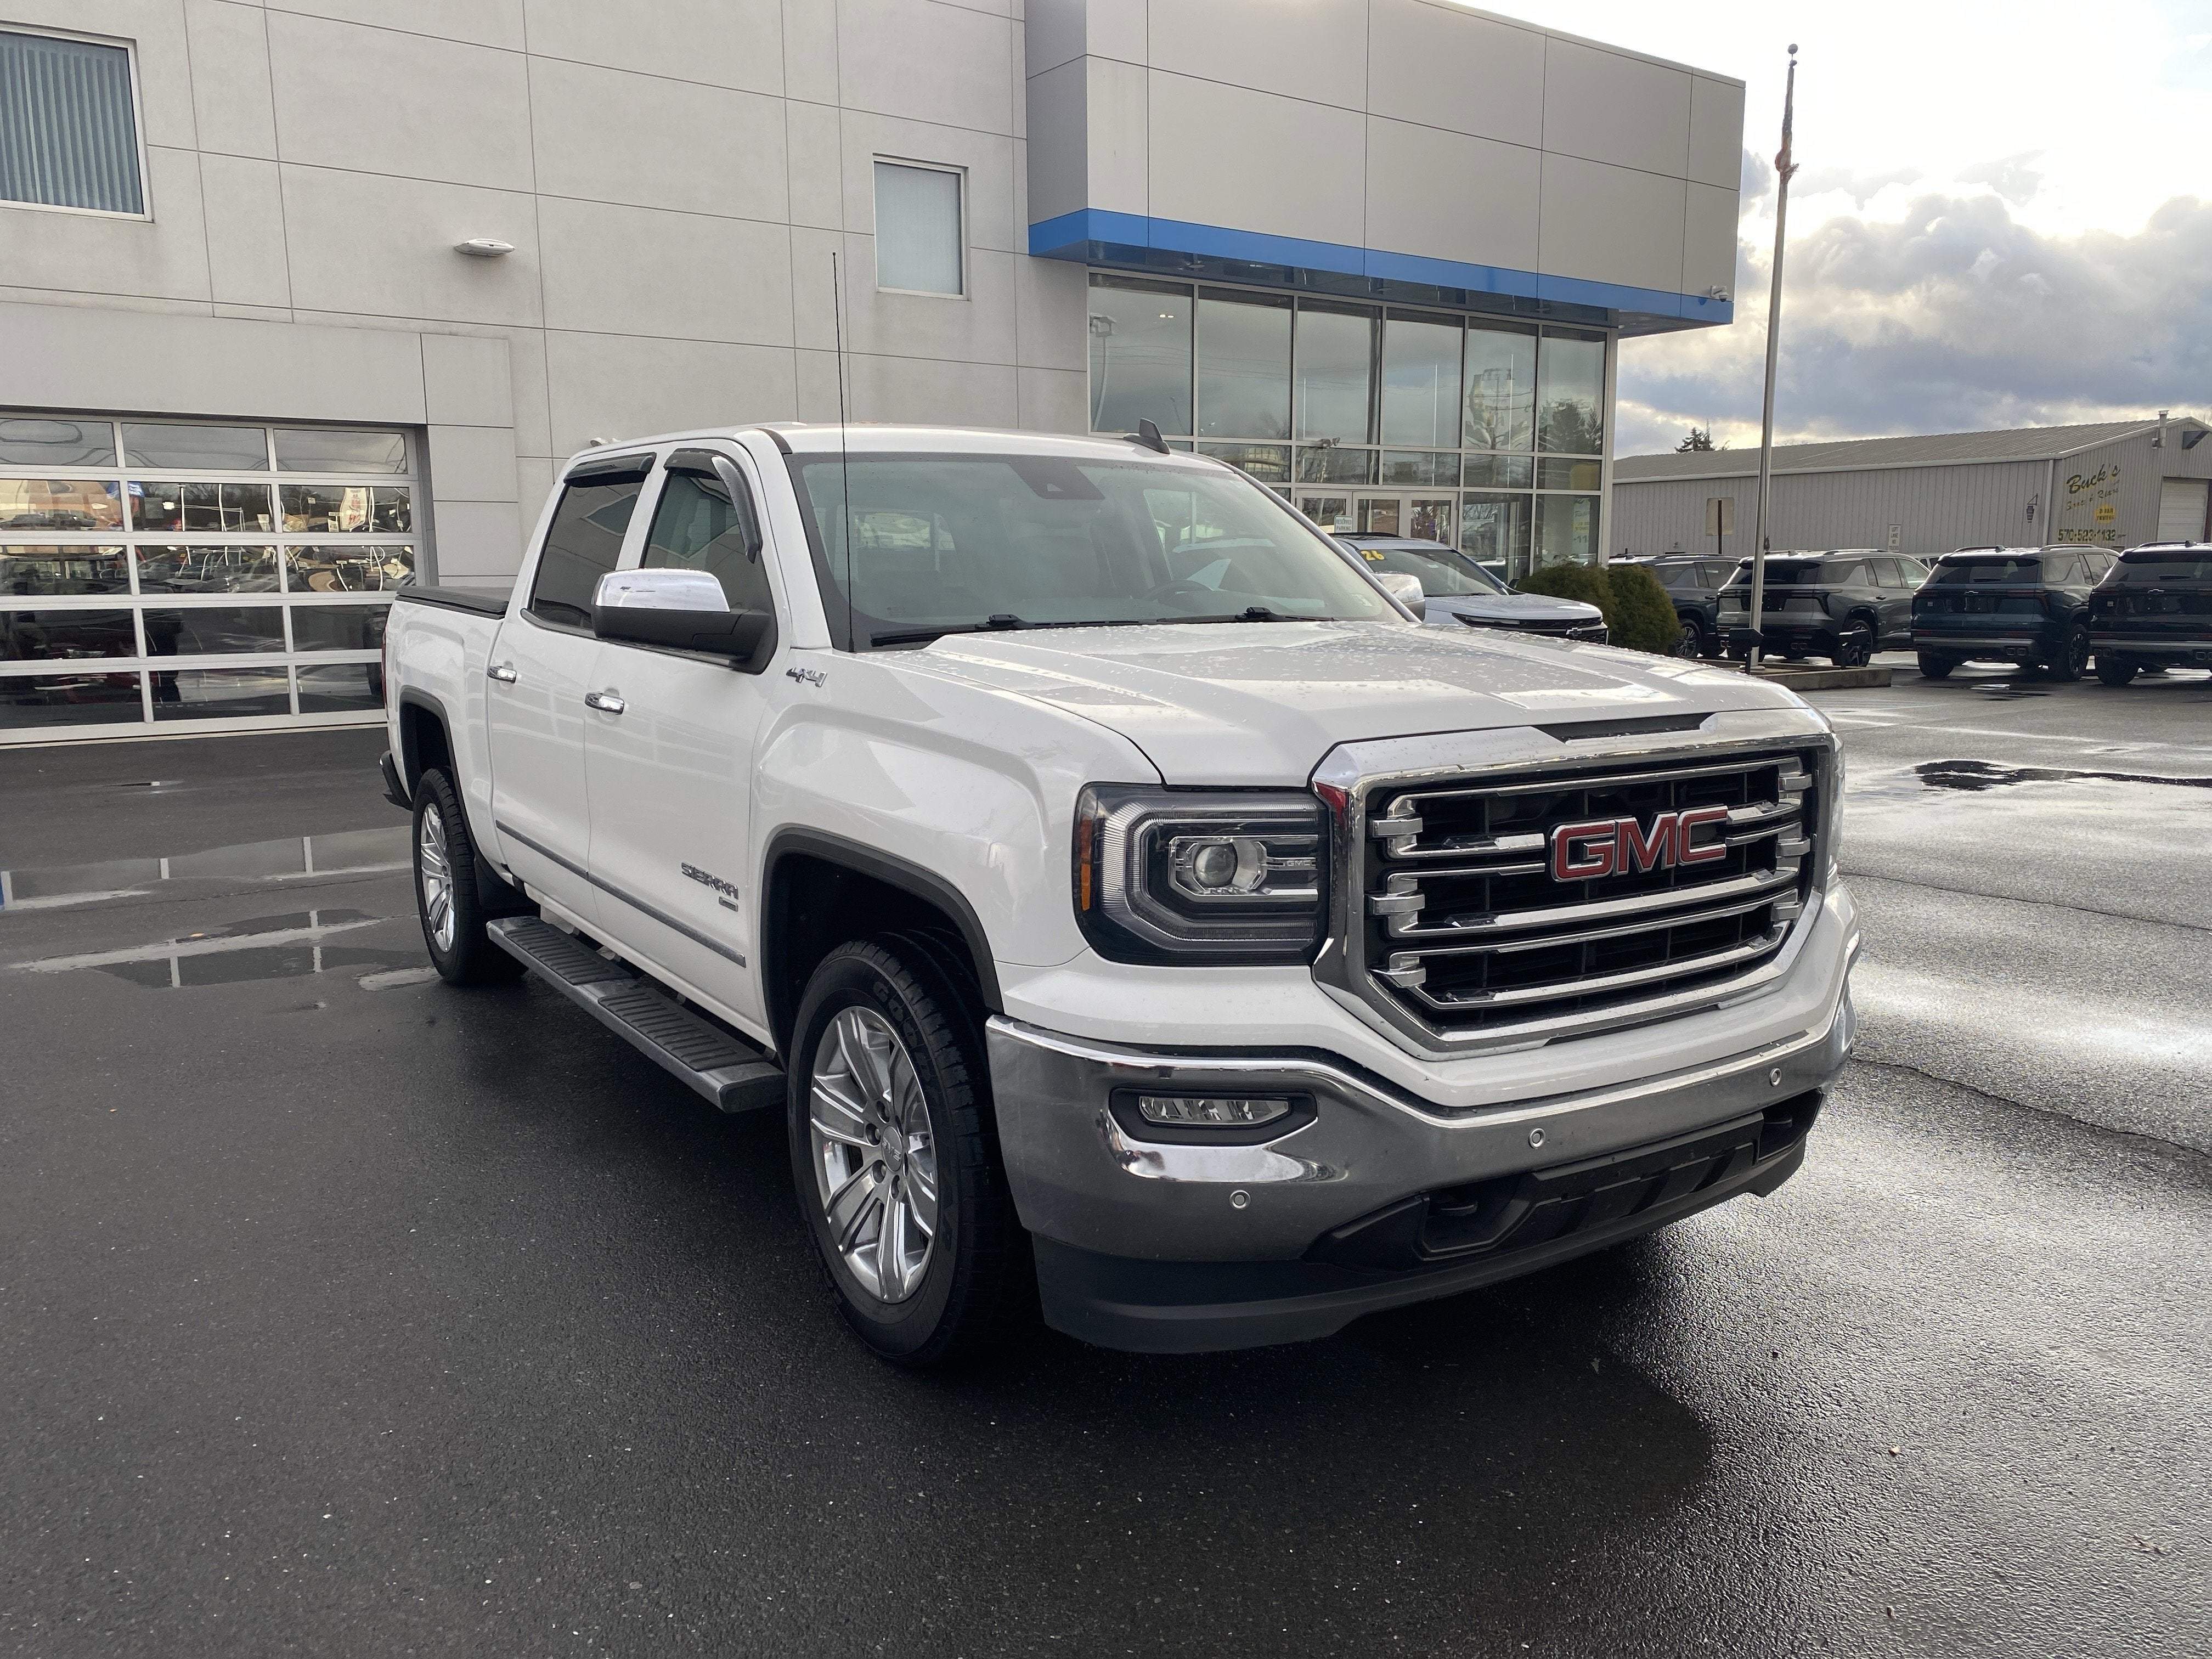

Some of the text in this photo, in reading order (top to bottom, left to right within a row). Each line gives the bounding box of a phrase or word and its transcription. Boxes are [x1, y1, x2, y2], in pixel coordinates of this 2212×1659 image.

[2066, 464, 2121, 494] Buck's
[1361, 550, 1385, 561] 26
[1551, 805, 1728, 882] GMC
[681, 861, 738, 900] SIERRA
